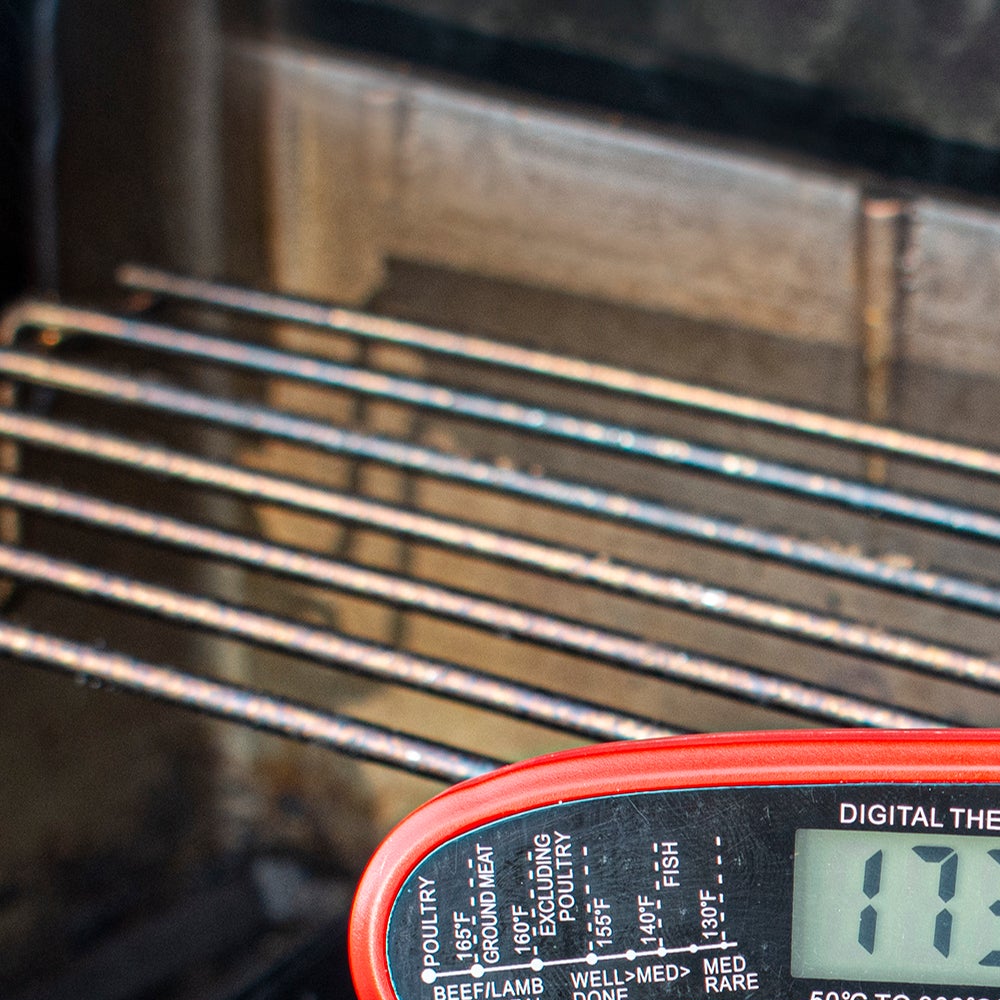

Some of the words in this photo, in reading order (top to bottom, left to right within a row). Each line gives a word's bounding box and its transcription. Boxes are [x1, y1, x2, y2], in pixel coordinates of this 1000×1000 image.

[839, 803, 943, 828] DIGITAL
[476, 843, 495, 889] MEAT
[534, 833, 556, 937] EXCLUDING
[554, 831, 575, 922] POULTRY
[663, 841, 680, 887] FISH
[418, 876, 440, 967] POULTRY
[453, 911, 473, 961] 165°F
[479, 891, 500, 965] GROUND
[512, 905, 532, 955] 160°F
[594, 898, 613, 948] 155°F
[638, 895, 657, 945] 140°F
[700, 889, 719, 940] 130°F
[703, 956, 746, 976] MED
[705, 973, 759, 993] RARE
